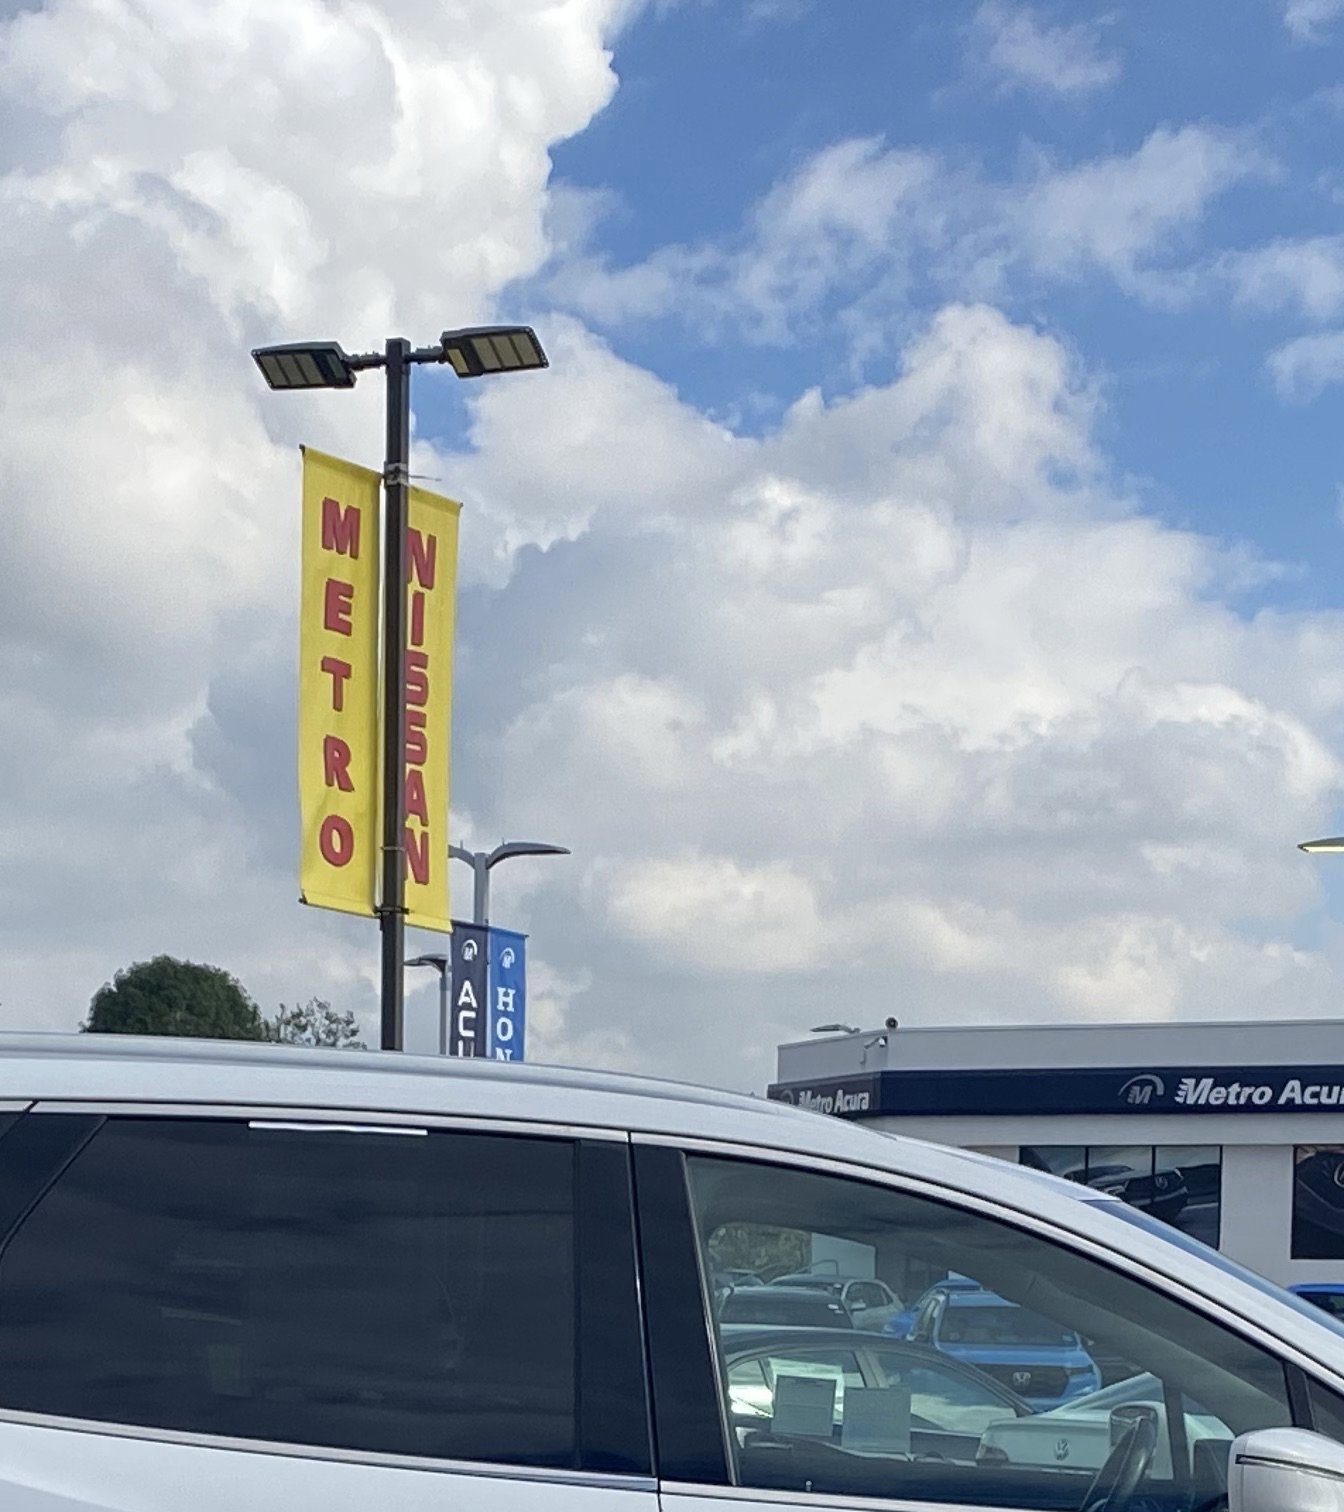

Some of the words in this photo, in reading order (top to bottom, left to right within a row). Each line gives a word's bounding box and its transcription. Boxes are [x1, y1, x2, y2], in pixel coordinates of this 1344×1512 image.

[320, 497, 361, 867] METRO
[404, 526, 437, 886] NISSAN
[457, 980, 478, 1058] ACU
[496, 986, 516, 1061] HON
[834, 1089, 871, 1113] Acura
[1174, 1078, 1273, 1105] Metro
